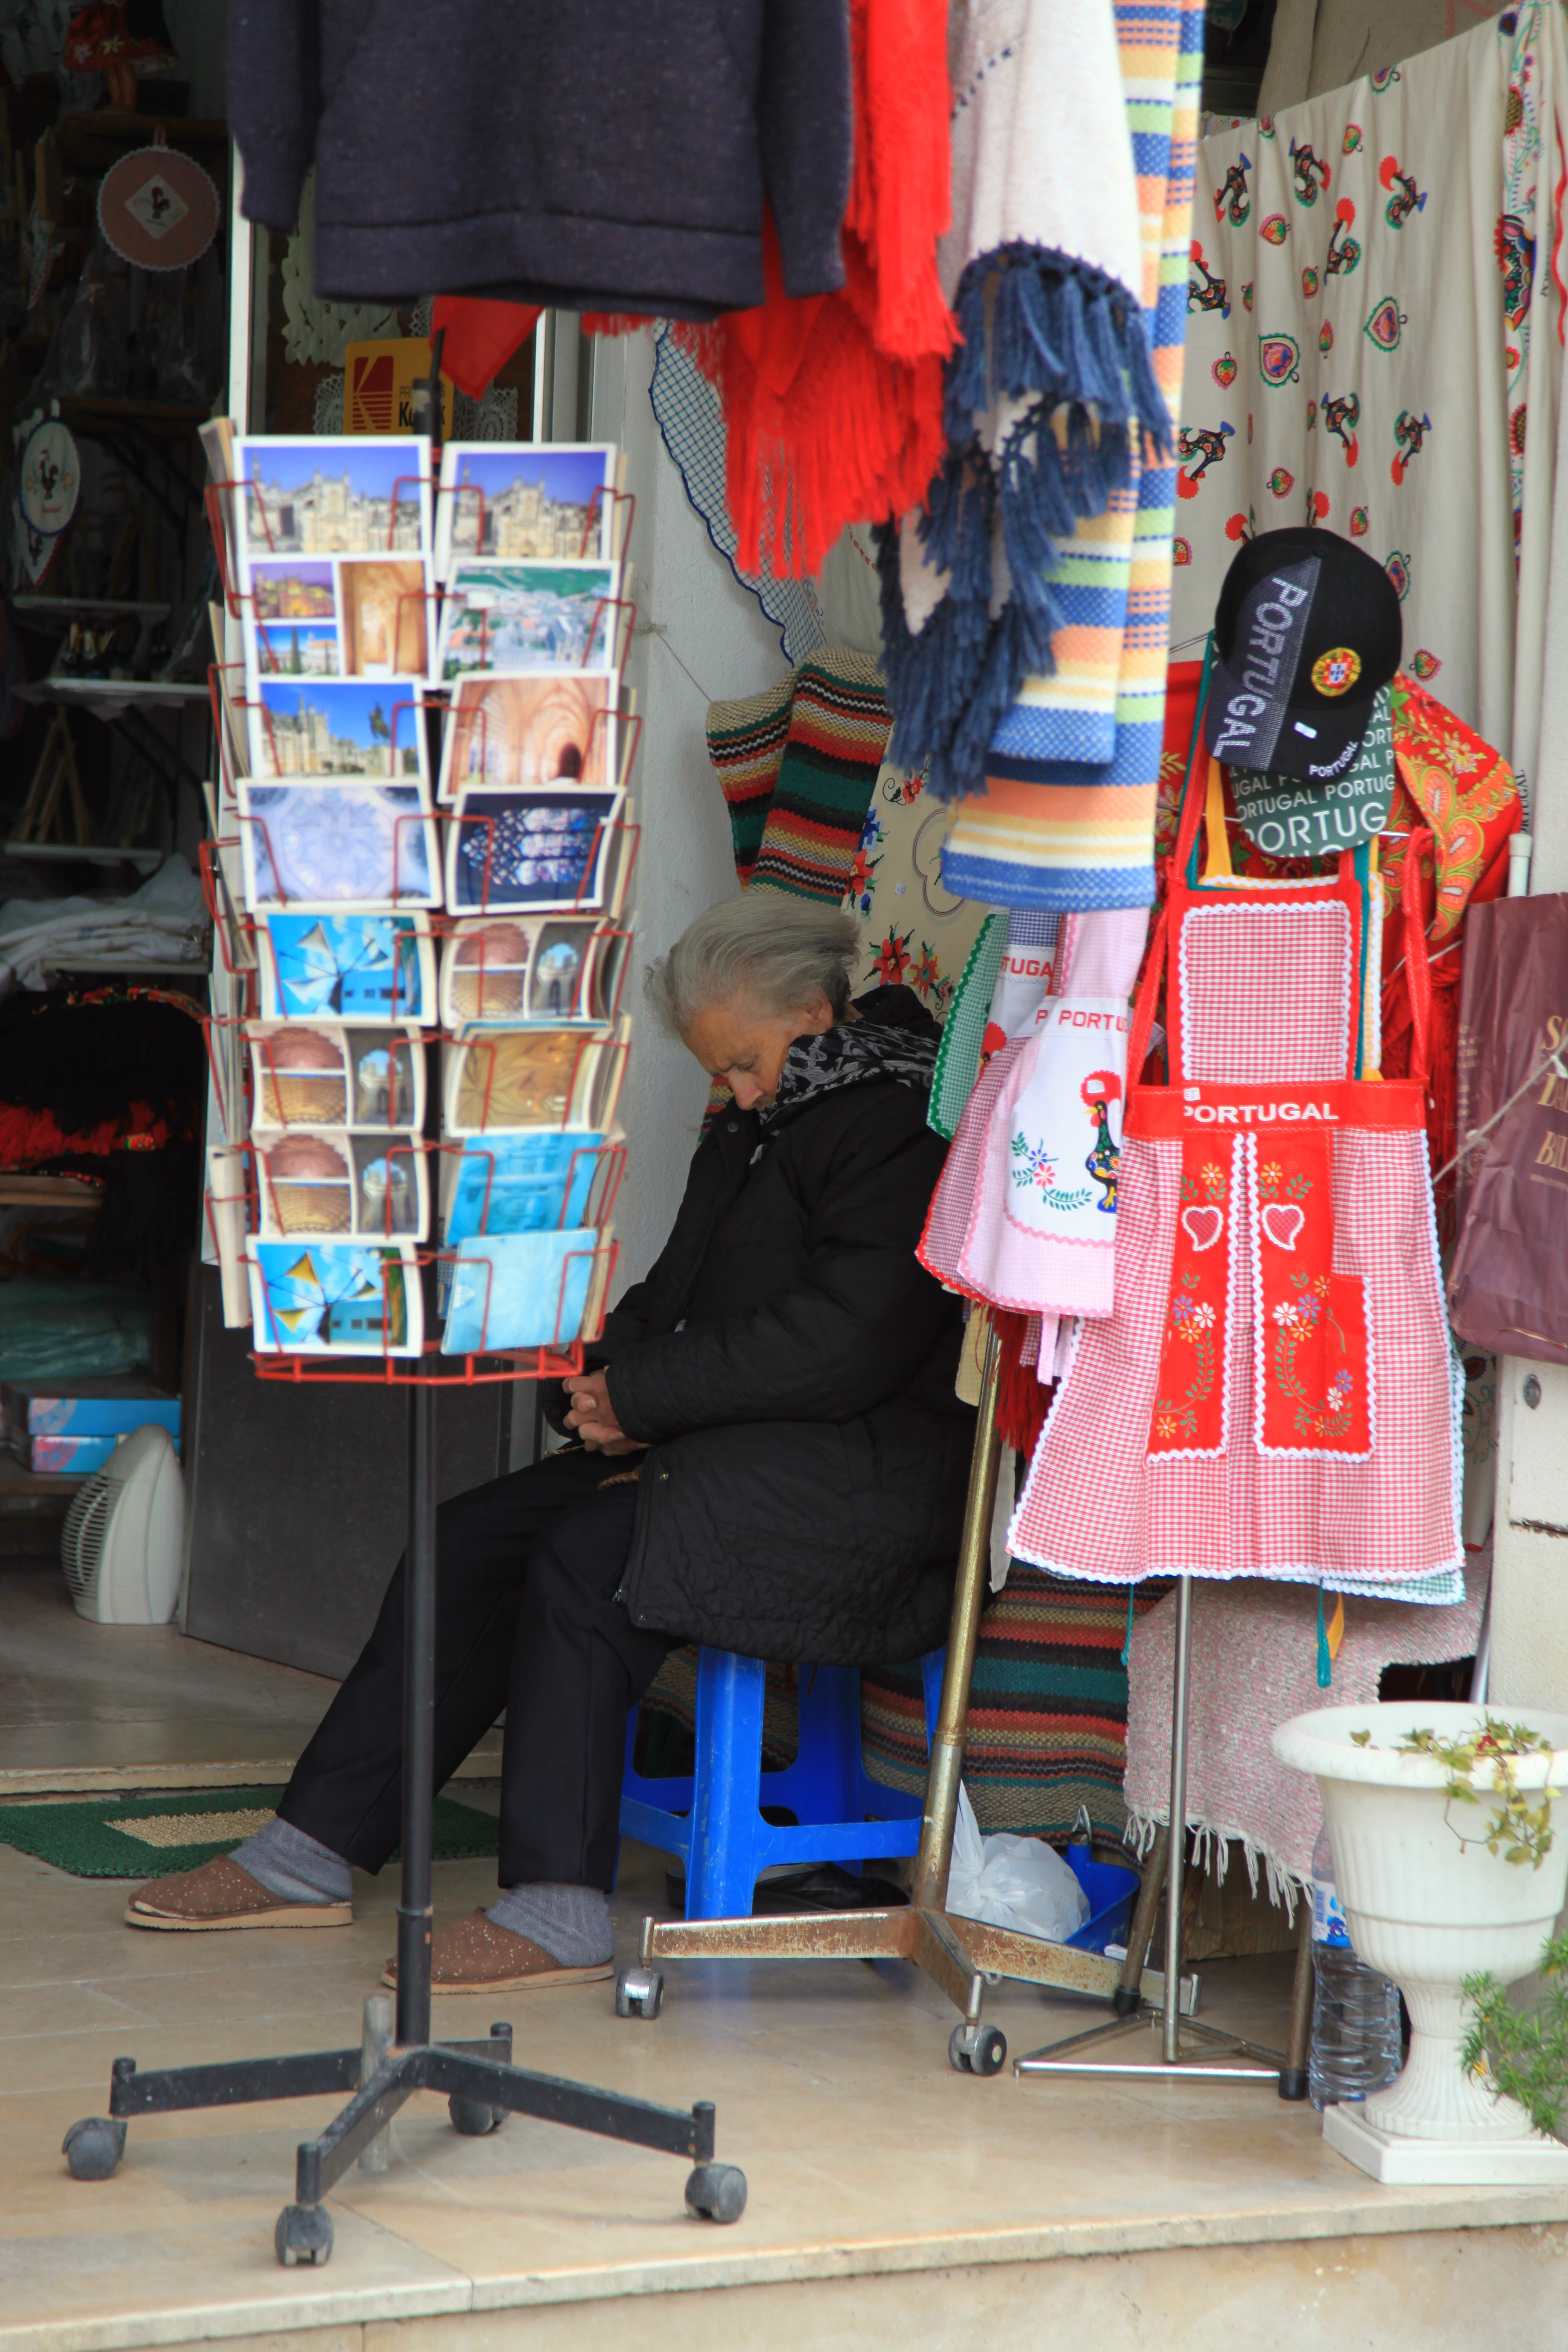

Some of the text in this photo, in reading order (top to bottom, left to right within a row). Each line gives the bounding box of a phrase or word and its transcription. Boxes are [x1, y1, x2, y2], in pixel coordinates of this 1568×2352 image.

[1213, 577, 1309, 757] PORTUGAL
[1309, 741, 1359, 777] PORTUGAL
[1184, 1102, 1340, 1123] PORTUGAL
